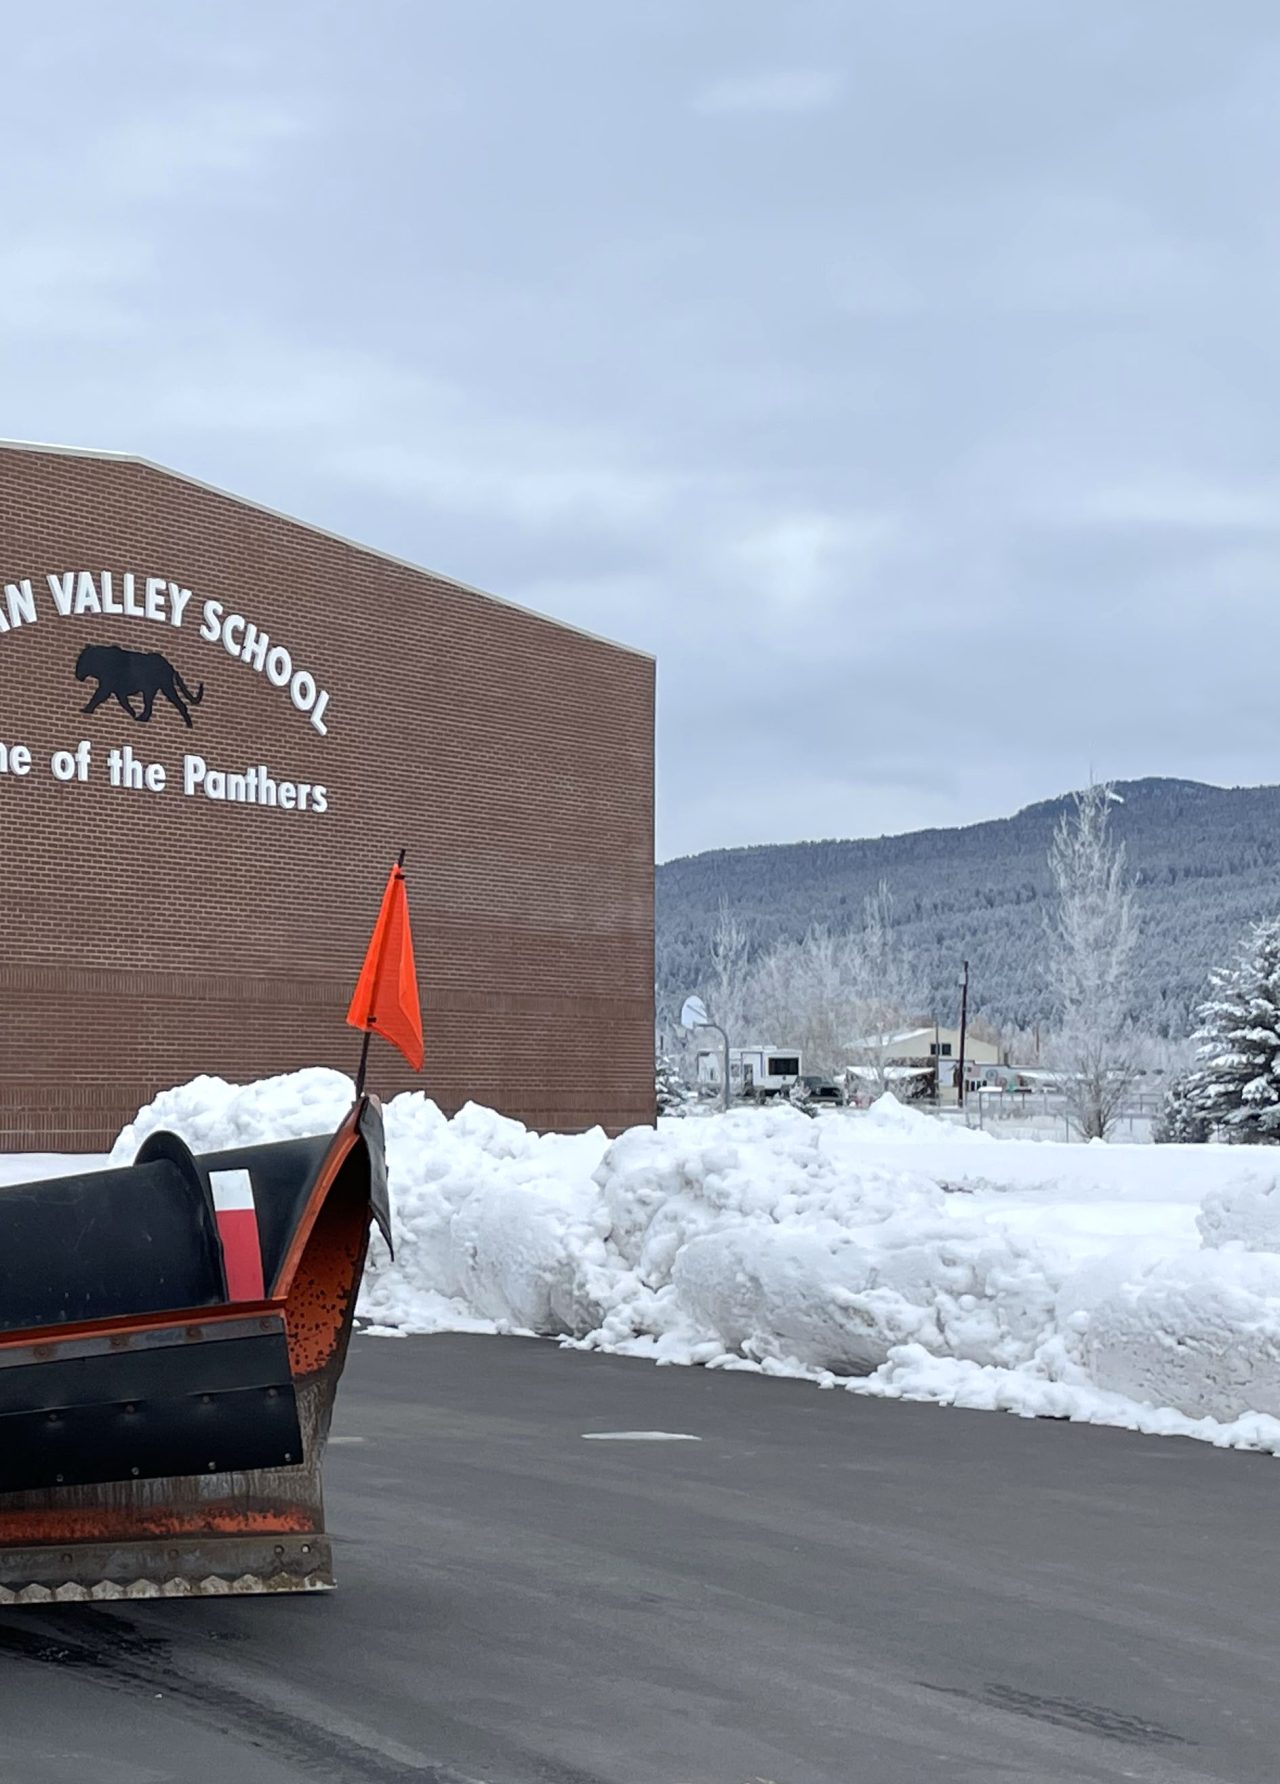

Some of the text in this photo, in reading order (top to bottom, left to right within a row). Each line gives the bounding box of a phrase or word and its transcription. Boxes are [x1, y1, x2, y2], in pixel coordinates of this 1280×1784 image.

[46, 570, 192, 627] VALLEY
[199, 600, 330, 736] SCHOOL
[51, 740, 91, 781] of
[108, 746, 167, 792] the
[183, 754, 328, 813] Panthers
